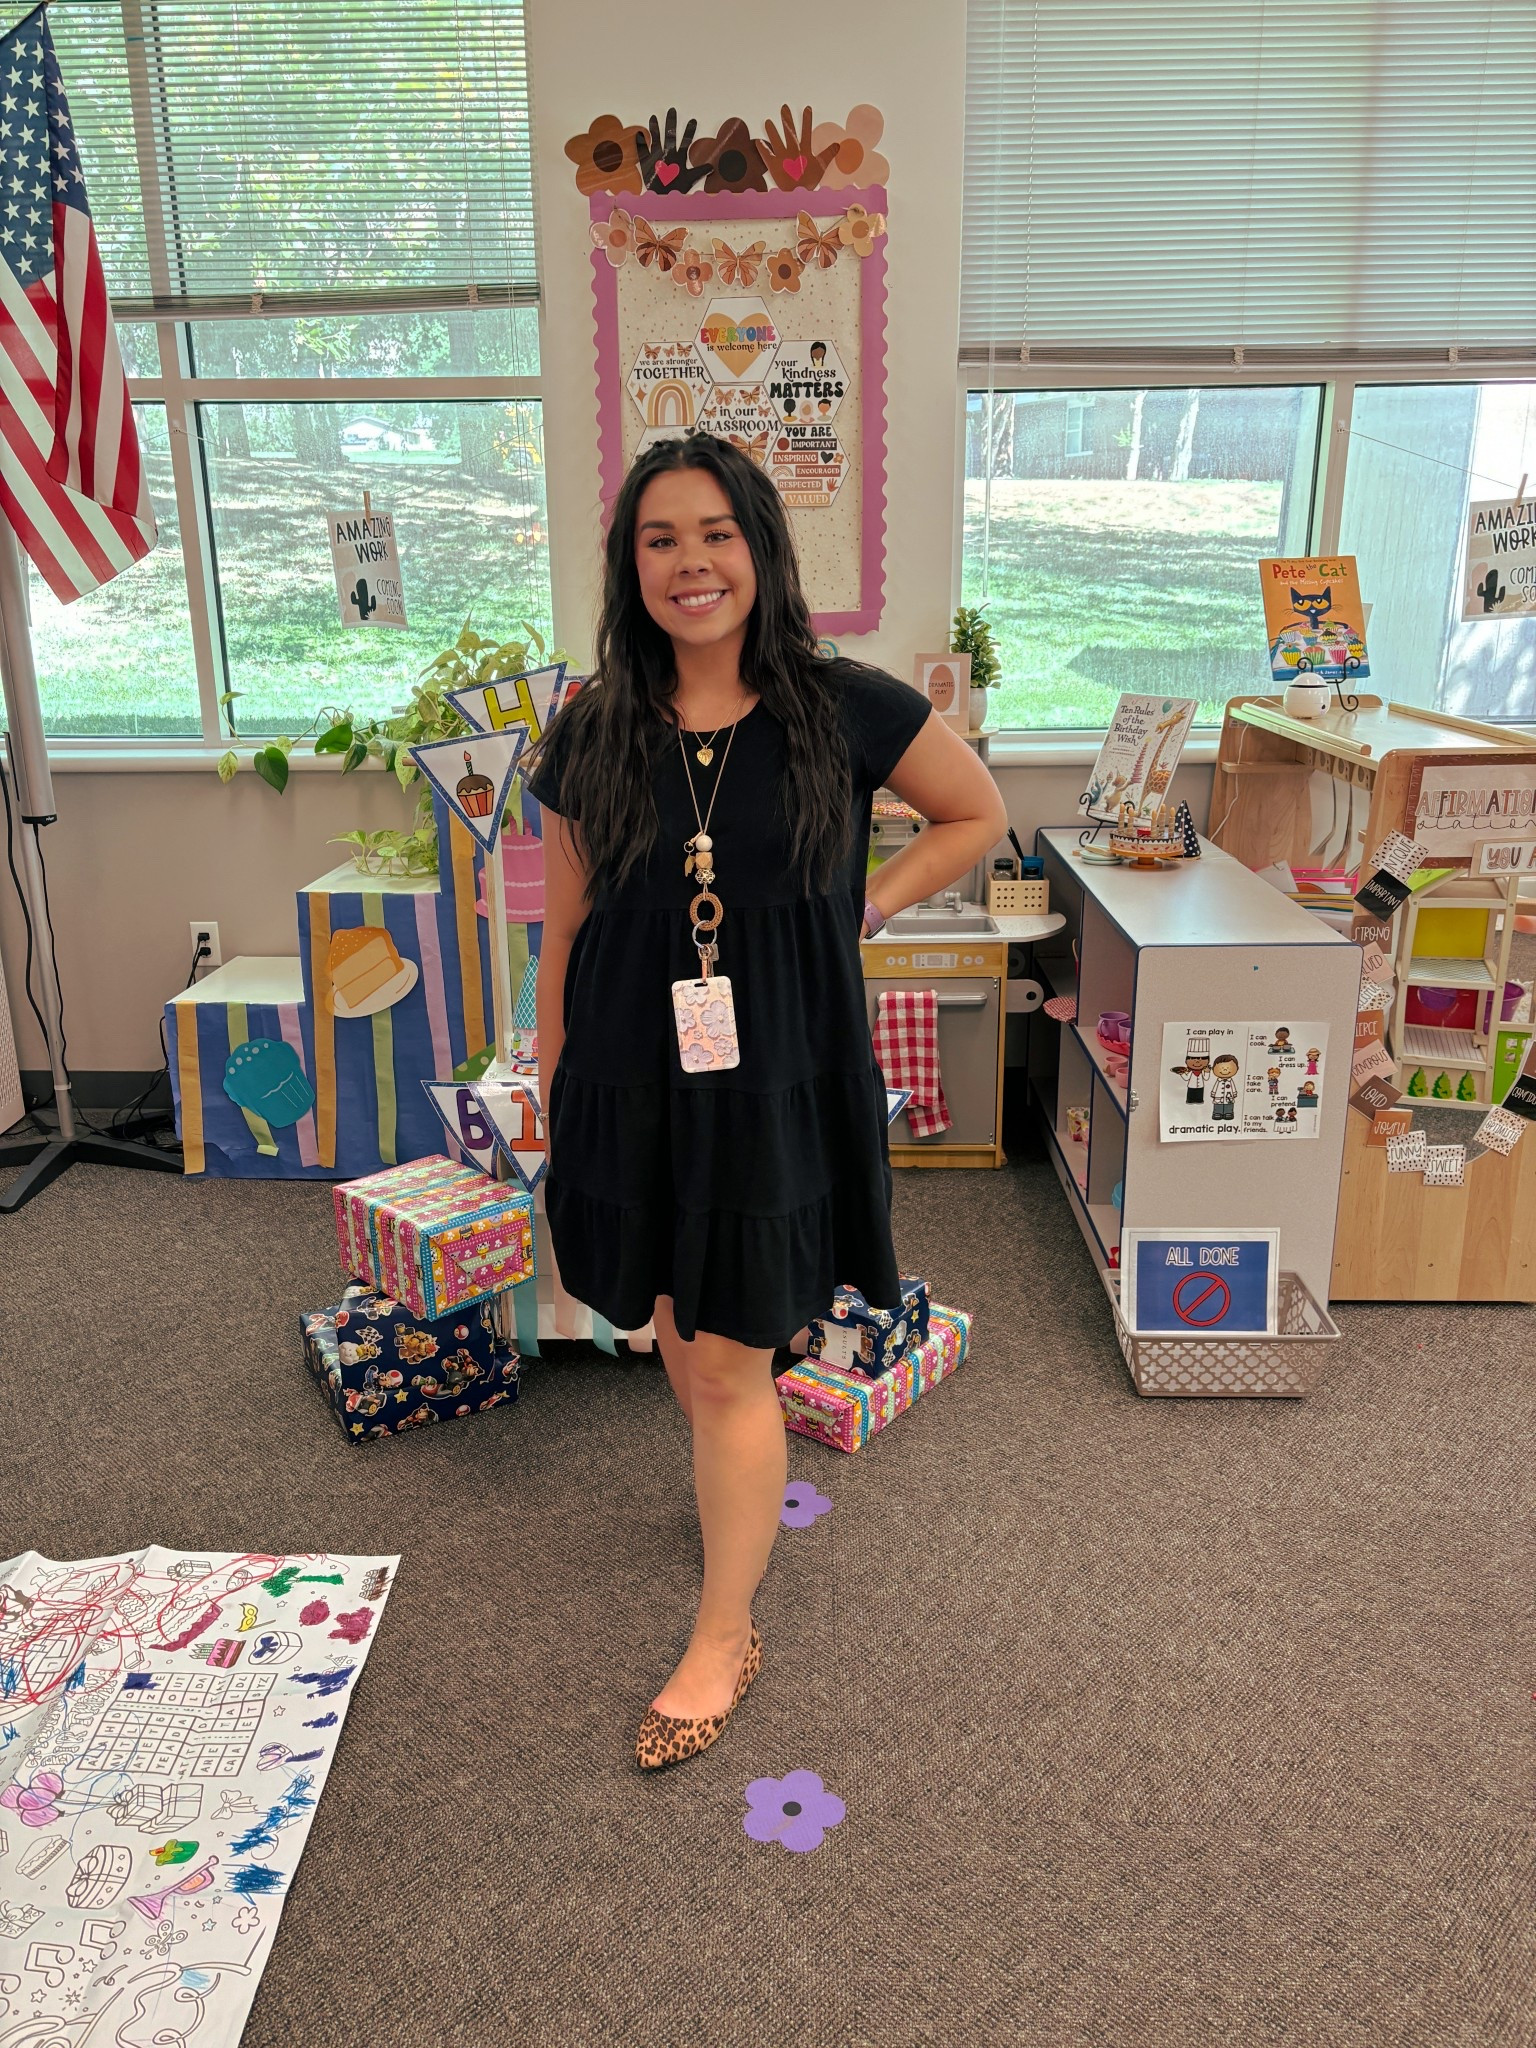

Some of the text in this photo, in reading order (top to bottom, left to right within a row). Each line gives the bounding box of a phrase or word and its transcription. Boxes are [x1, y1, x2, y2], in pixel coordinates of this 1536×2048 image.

[700, 326, 776, 343] EVERYONE
[707, 341, 777, 353] is welcome here
[665, 358, 698, 366] stronger
[775, 360, 798, 369] your
[634, 366, 710, 384] TOGETHER
[782, 367, 836, 382] kindness
[770, 382, 844, 398] MATTERS
[720, 406, 757, 419] in our
[698, 420, 779, 437] CLASSROOM
[785, 426, 832, 437] YOU ARE
[792, 440, 837, 448] IMPORTANT
[774, 453, 817, 463] INSPIRING
[796, 467, 840, 475] ENCOURAGED
[779, 480, 822, 489] RESPECTED
[789, 494, 829, 504] VALUED
[336, 517, 391, 544] AMAZING
[355, 541, 388, 564] WORK
[1272, 563, 1347, 579] Pete the Cat
[1121, 703, 1156, 716] Ten Rules
[1122, 715, 1145, 725] of the
[1114, 723, 1149, 739] Birthday
[1117, 734, 1139, 746] Wish
[1415, 790, 1536, 817] AFFIRMATIO
[1487, 847, 1522, 869] YOU
[1364, 879, 1402, 910] IMPORTANT
[1352, 926, 1391, 942] STRONG
[1209, 1028, 1225, 1036] play
[1360, 1085, 1388, 1108] LOVED
[1169, 1123, 1241, 1134] dramatic play.
[1485, 1118, 1522, 1142] OPTIMISTIC
[1390, 1144, 1422, 1160] FUNNY
[1428, 1158, 1460, 1173] SWEET
[1165, 1247, 1240, 1266] ALL DONE
